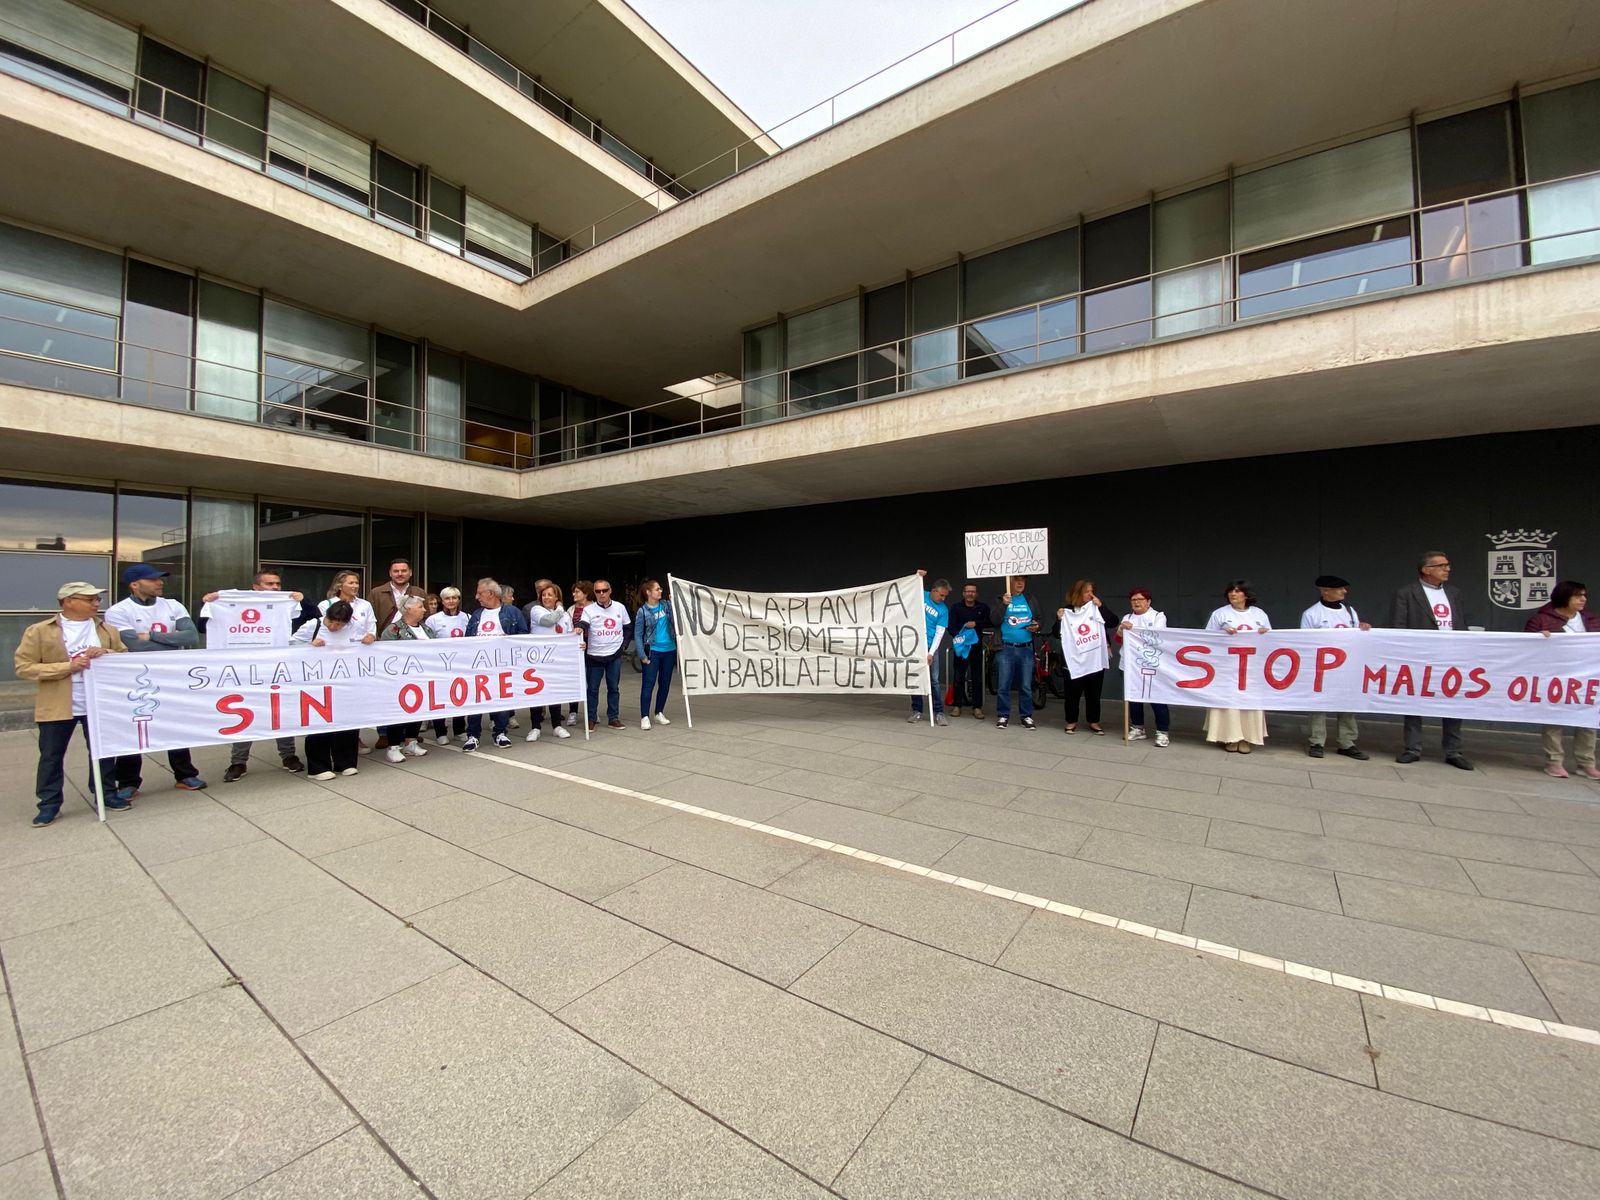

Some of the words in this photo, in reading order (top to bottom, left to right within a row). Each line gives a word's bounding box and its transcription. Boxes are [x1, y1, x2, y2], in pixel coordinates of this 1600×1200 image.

[965, 533, 1008, 547] NUESTROS
[1009, 530, 1046, 543] PUEBLOS
[982, 547, 1002, 561] NO
[1011, 545, 1038, 560] SON
[972, 559, 1045, 576] VERTEDEROS
[672, 580, 719, 636] NO
[788, 582, 908, 625] PLANTA
[229, 624, 271, 634] olores
[723, 622, 760, 652] DE
[1076, 632, 1100, 647] olores
[188, 655, 424, 690] SALAMANCA
[439, 651, 457, 671] Y
[472, 644, 558, 669] ALFOZ
[684, 659, 719, 690] EN
[1175, 645, 1347, 692] STOP
[1362, 664, 1491, 699] MALOS
[398, 669, 545, 714] OLORES
